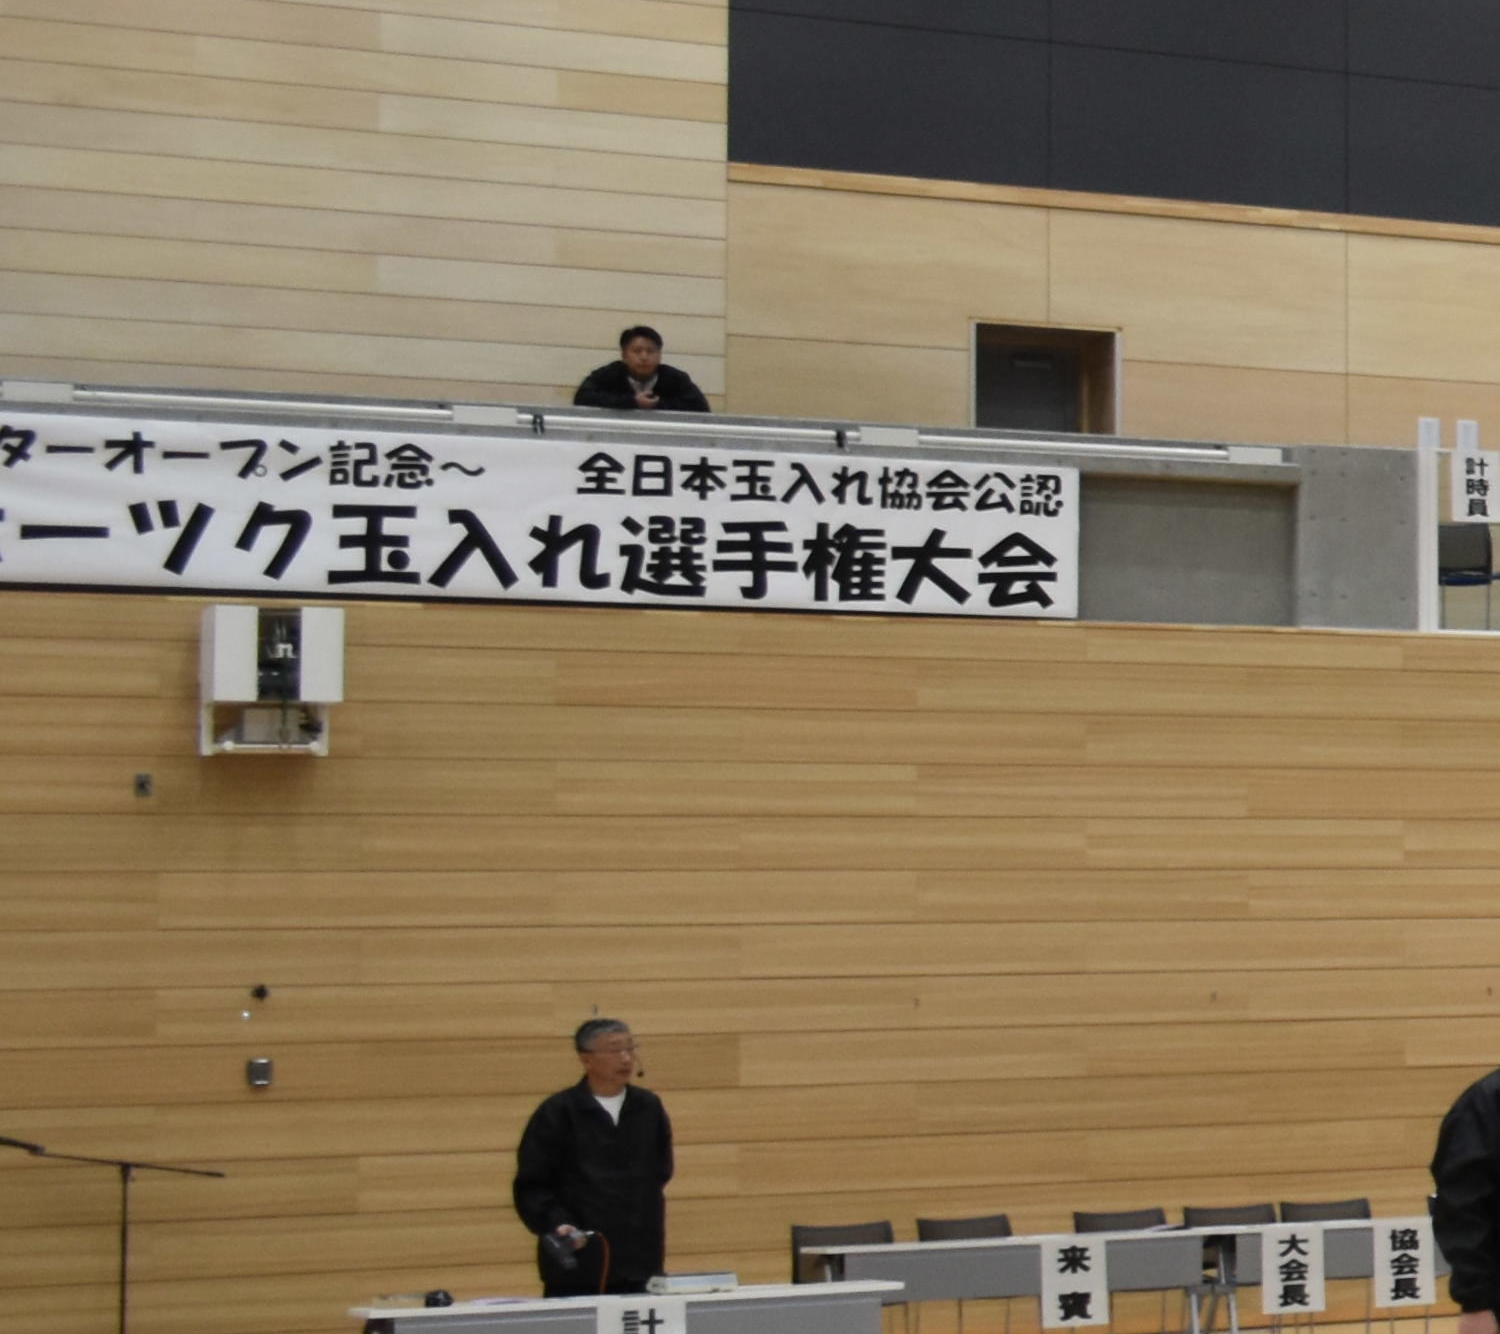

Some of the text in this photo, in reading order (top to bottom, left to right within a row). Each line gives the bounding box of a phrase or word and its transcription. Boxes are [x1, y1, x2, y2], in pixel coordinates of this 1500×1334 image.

[577, 454, 1063, 518] 全日本玉入れ協会公認
[1465, 457, 1489, 517] 計時員
[0, 500, 1060, 610] ーツク玉入れ選手権大会
[1057, 1246, 1092, 1321] 来賓
[1278, 1234, 1310, 1307] 大会長
[1390, 1228, 1420, 1301] 協会長
